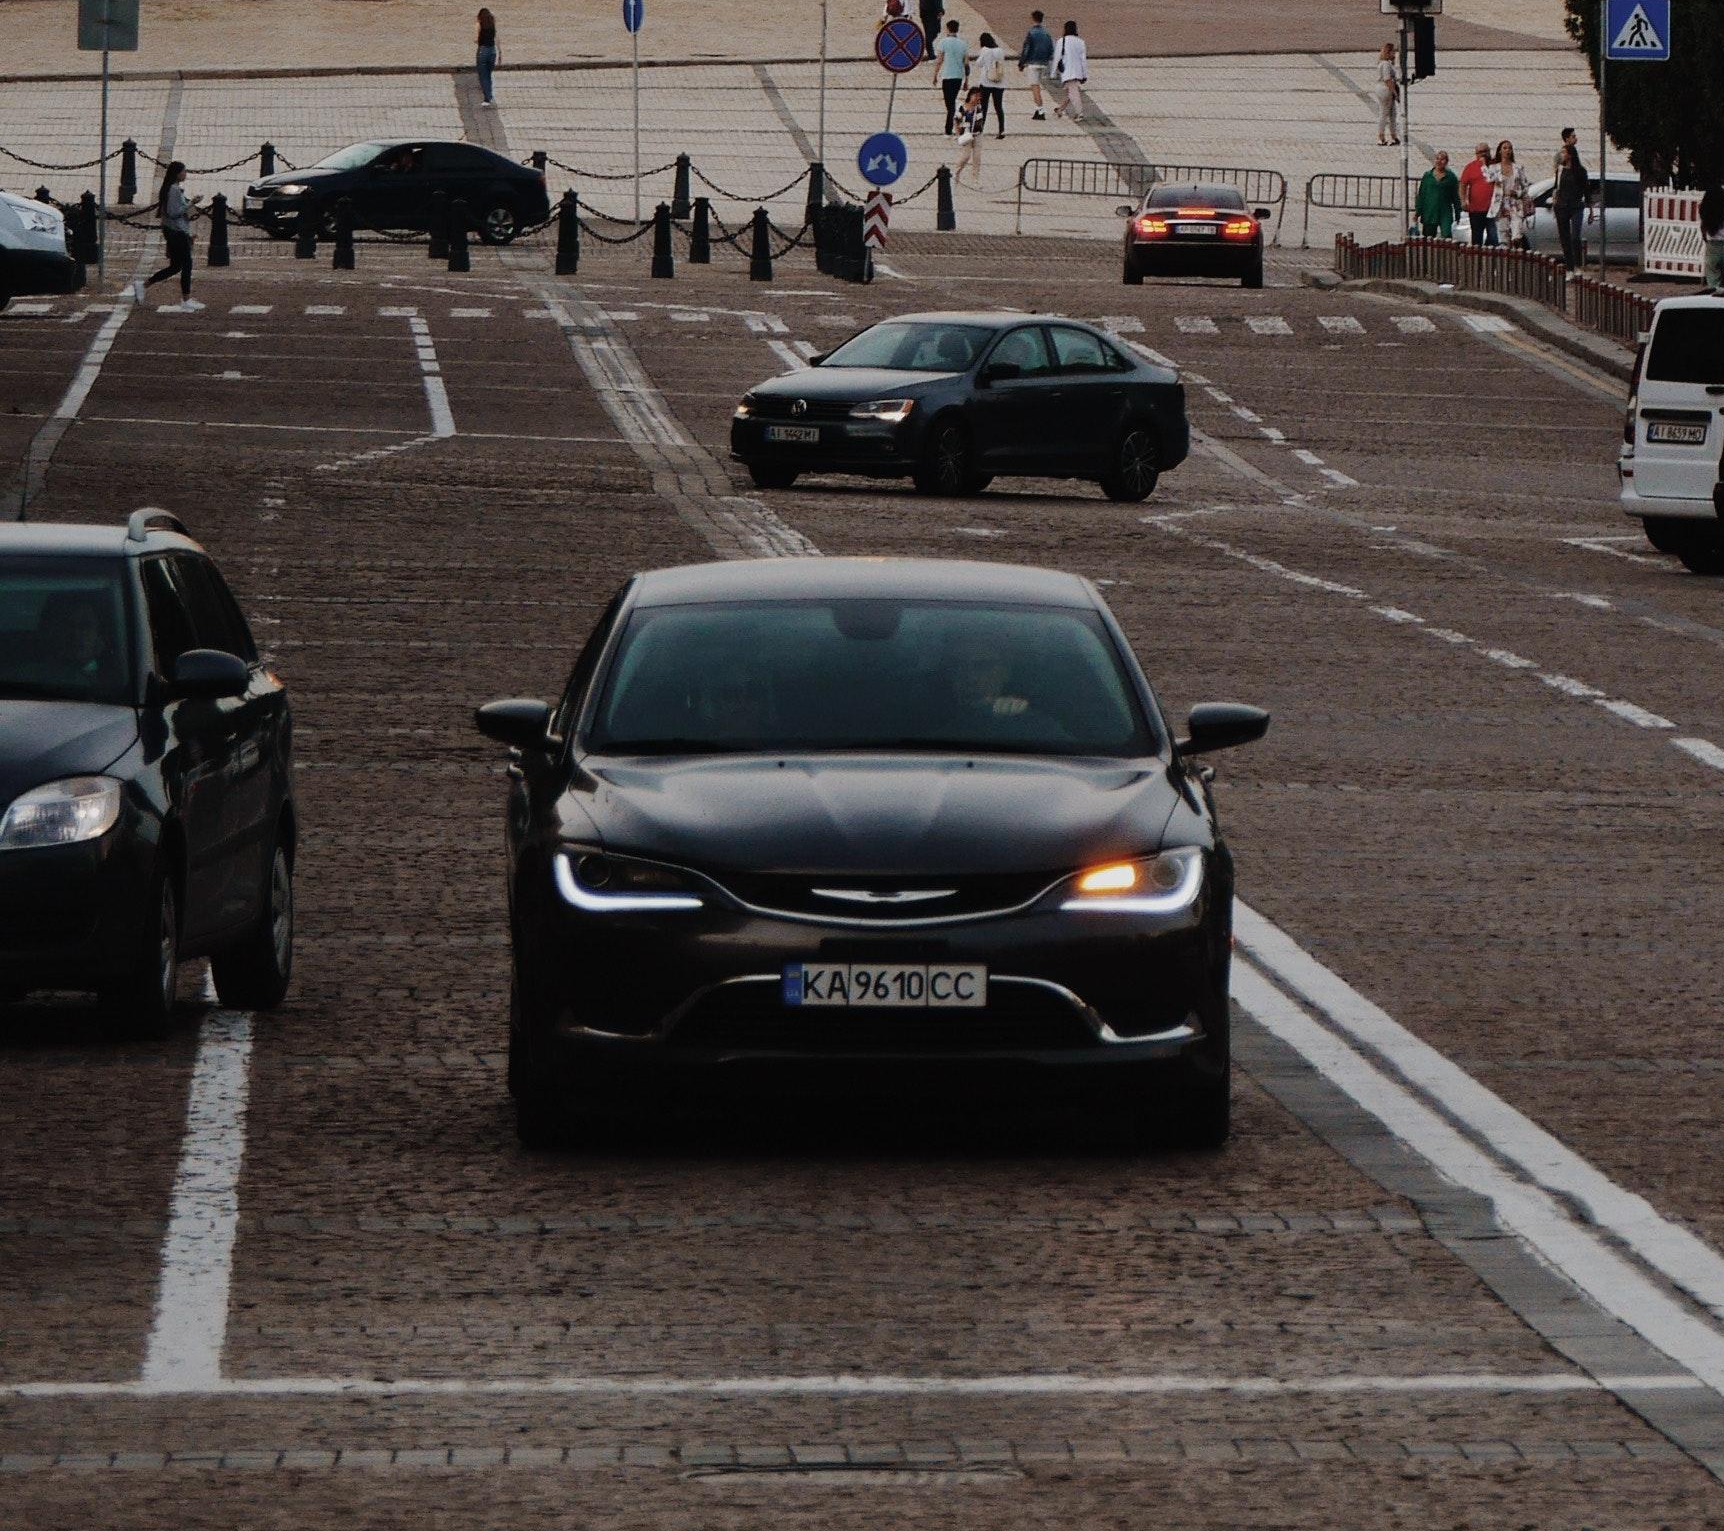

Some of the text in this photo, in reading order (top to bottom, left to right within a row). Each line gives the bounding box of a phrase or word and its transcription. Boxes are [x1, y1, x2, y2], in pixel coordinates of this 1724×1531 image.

[803, 970, 975, 1000] KA 9610 CC
